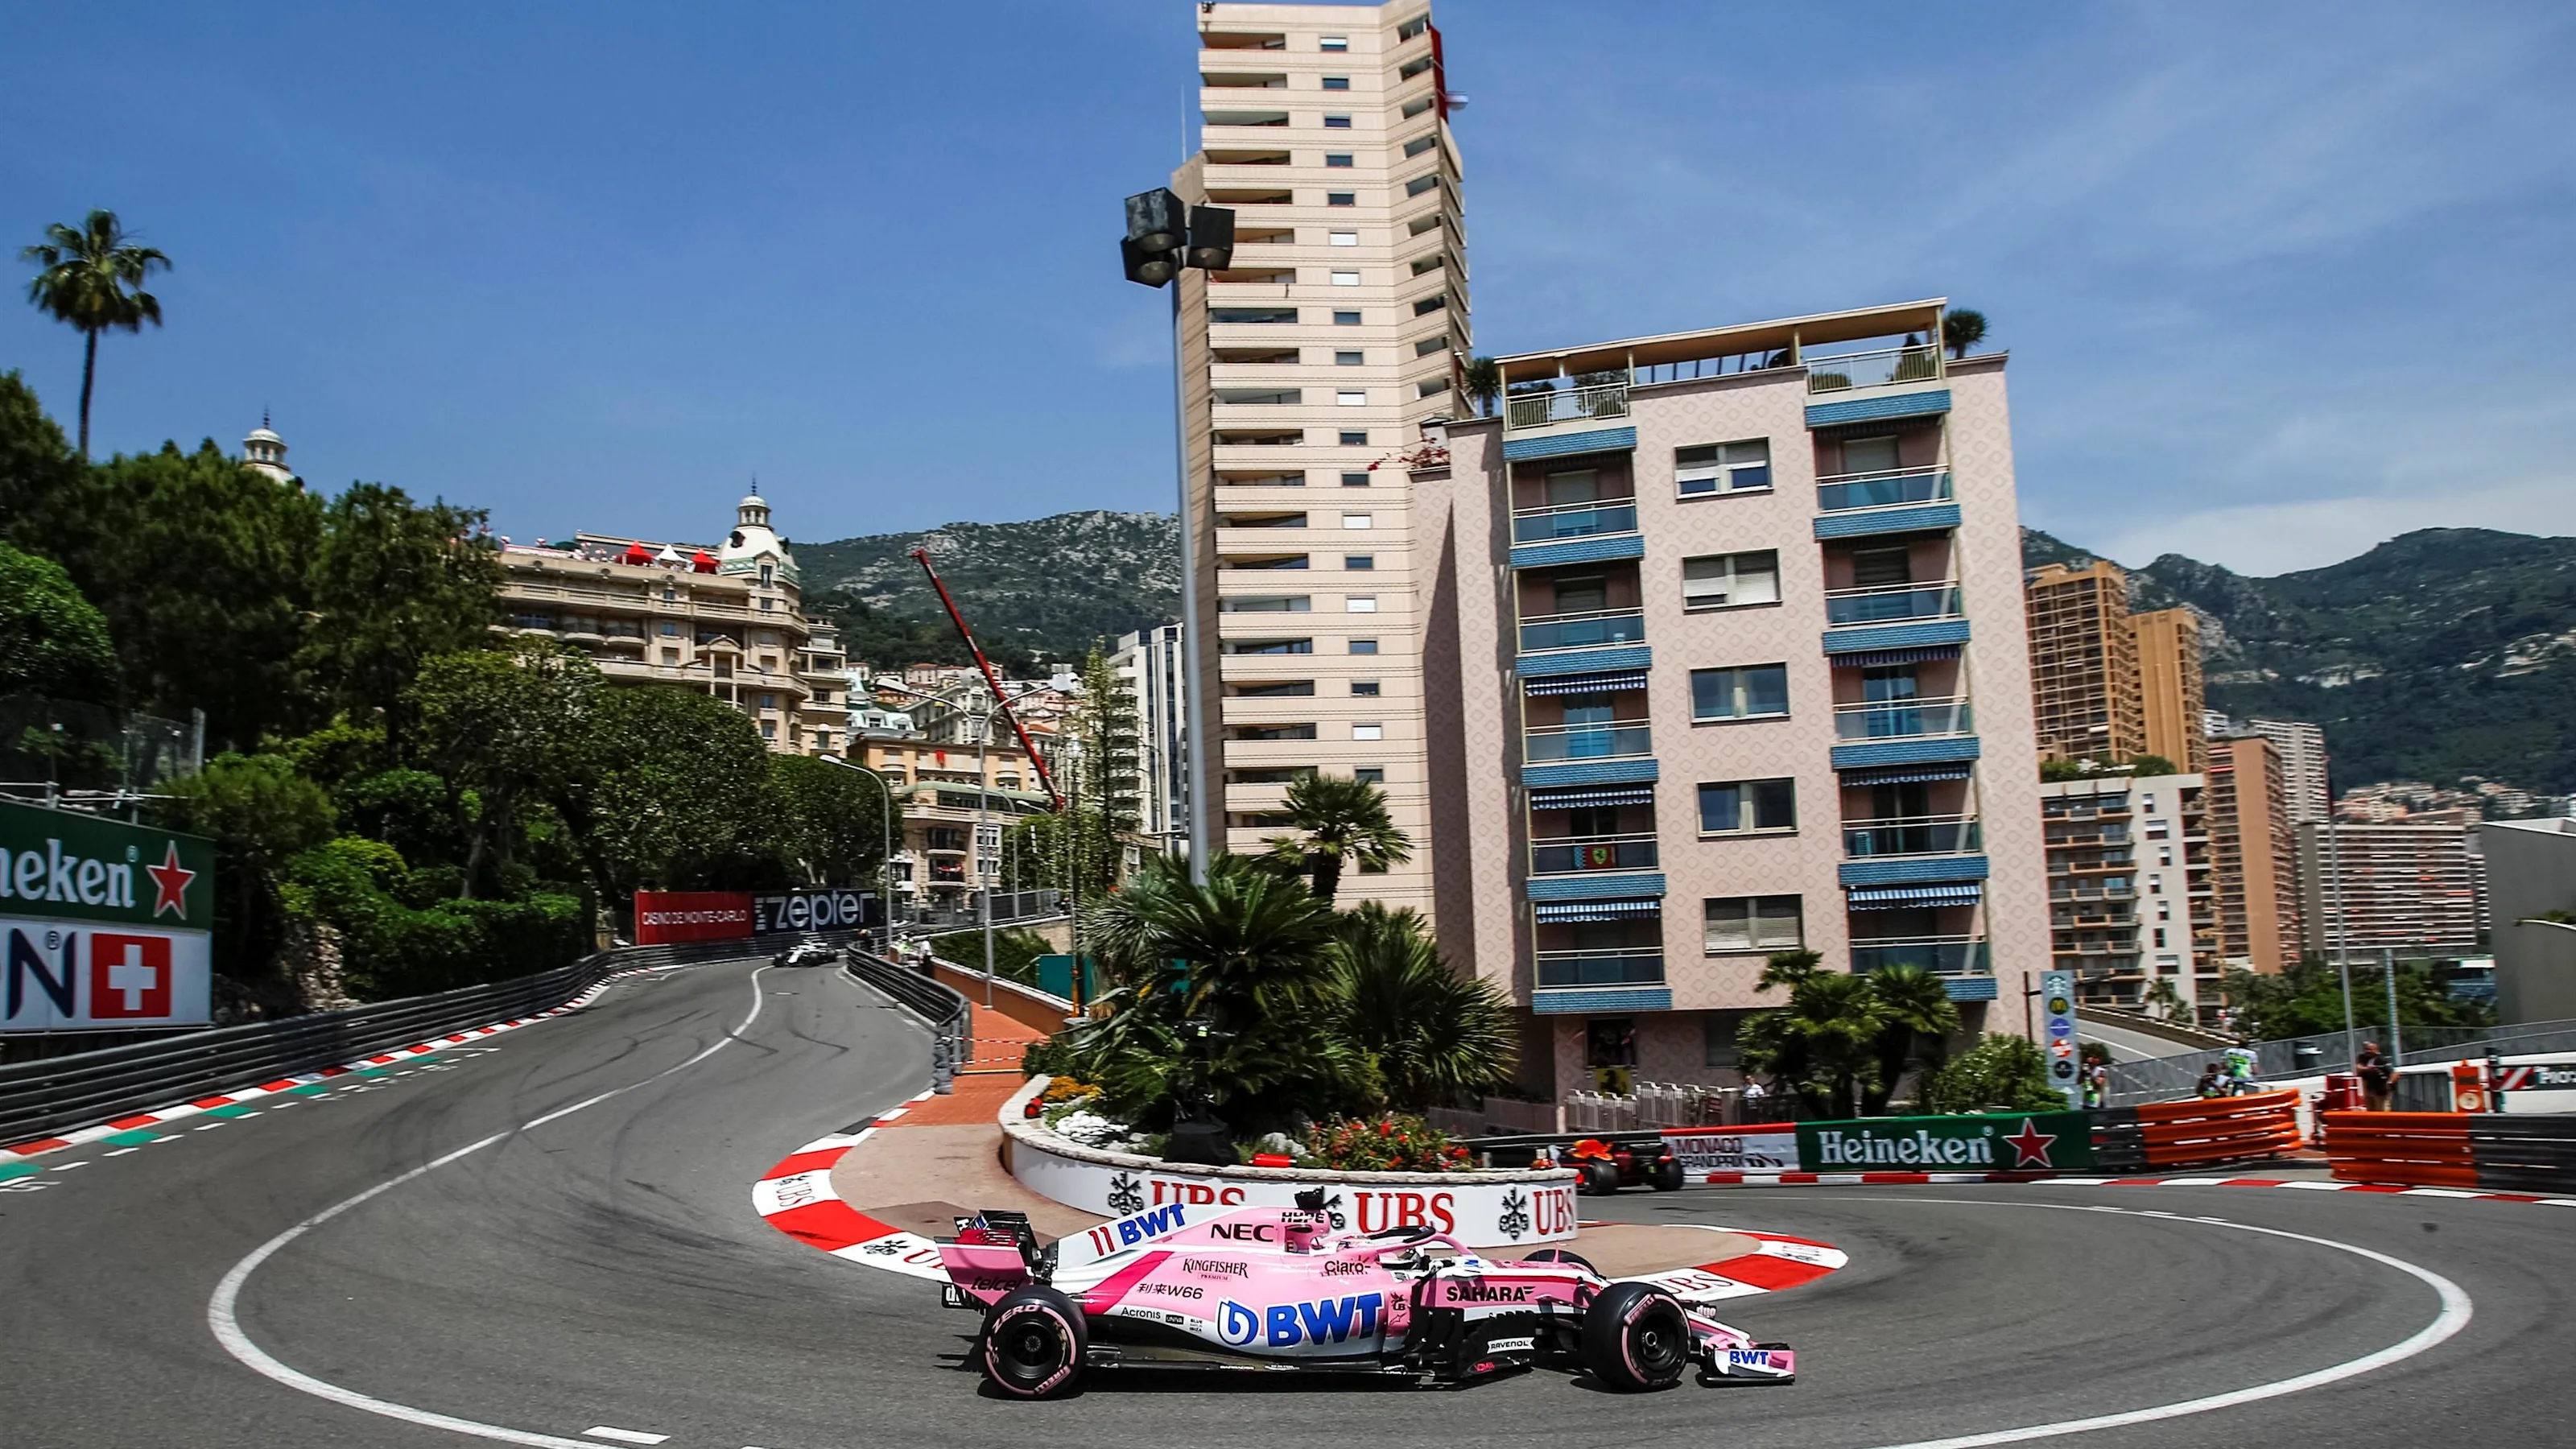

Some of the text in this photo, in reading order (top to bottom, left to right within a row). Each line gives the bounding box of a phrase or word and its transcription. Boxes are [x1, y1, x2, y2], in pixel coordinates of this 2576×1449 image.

[766, 890, 876, 931] zepter
[1676, 1137, 1743, 1154] MONACO
[1817, 1129, 1995, 1164] Heineken
[1282, 1212, 1324, 1224] HYPE
[1354, 1192, 1455, 1235] UBS
[1533, 1188, 1575, 1236] UBS
[1088, 1203, 1186, 1256] 11 BWT
[1211, 1224, 1274, 1242] NEC
[1183, 1258, 1249, 1278] KINGFISHER
[971, 1276, 1023, 1291] telcel
[1447, 1286, 1526, 1302] SAHARA
[992, 1305, 1041, 1335] ZERO
[1121, 1307, 1161, 1319] Acronis
[1267, 1292, 1383, 1347] BWT
[1491, 1340, 1529, 1350] RAVENOL
[1730, 1351, 1769, 1365] BWT
